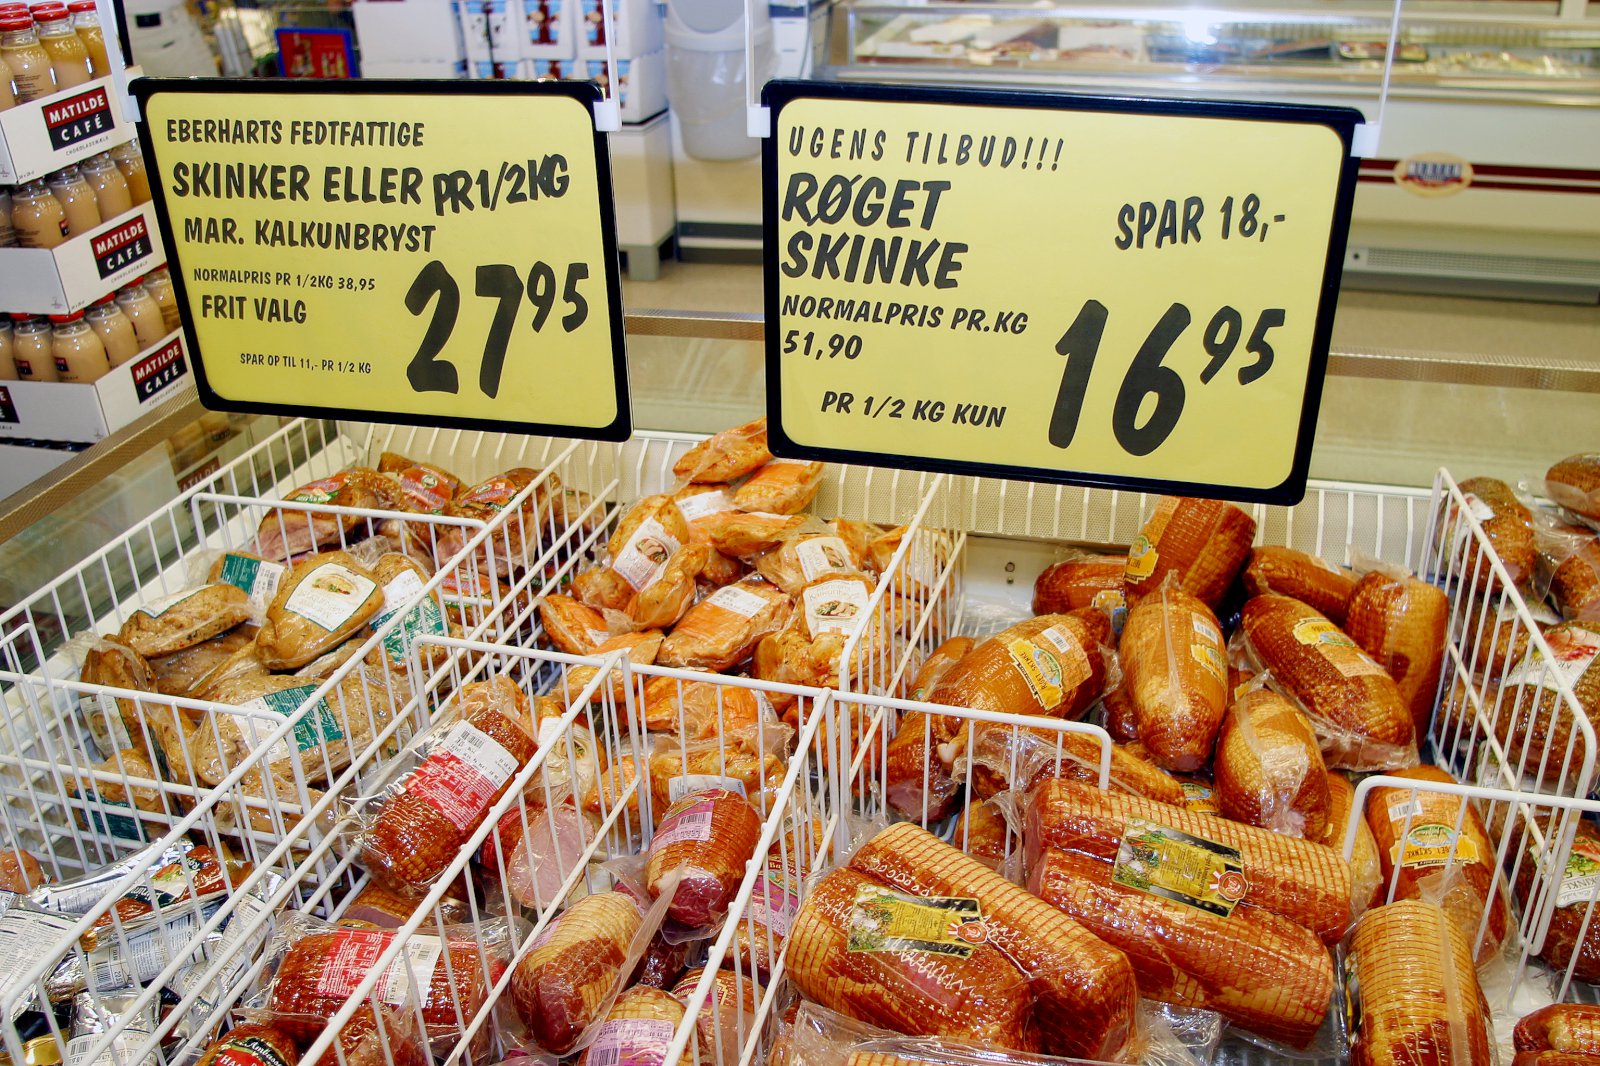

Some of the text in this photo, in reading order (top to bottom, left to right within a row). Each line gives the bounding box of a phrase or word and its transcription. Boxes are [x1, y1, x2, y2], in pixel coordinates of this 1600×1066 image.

[49, 94, 105, 124] MATILDE
[61, 114, 104, 142] CAFÉ
[166, 118, 425, 147] EBERHARTS FEDTFATTIGE
[788, 125, 1064, 172] UGENS TILBUD!!!
[171, 161, 311, 202] SKINKER
[323, 166, 424, 205] ELLER
[781, 172, 952, 231] RØGET
[184, 216, 437, 254] MAR. KALKUNBRYST
[1114, 192, 1286, 251] SPAR 18,-
[96, 222, 145, 255] MATILDE
[106, 241, 144, 270] CAFÉ
[780, 230, 969, 290] SKINKE
[193, 267, 376, 292] NORMALPRIS PR 1/2KG 38,95
[201, 294, 307, 325] FRIT VALG
[781, 294, 1029, 335] NORMALPRIS PR.KG
[782, 329, 863, 361] 51,90
[135, 345, 180, 381] MATILDE
[145, 362, 180, 394] CAFÉ
[239, 352, 372, 374] SPAR OP TIL 11,- PR 1/2 KG
[820, 390, 1007, 428] PR 1/2 KG KUN
